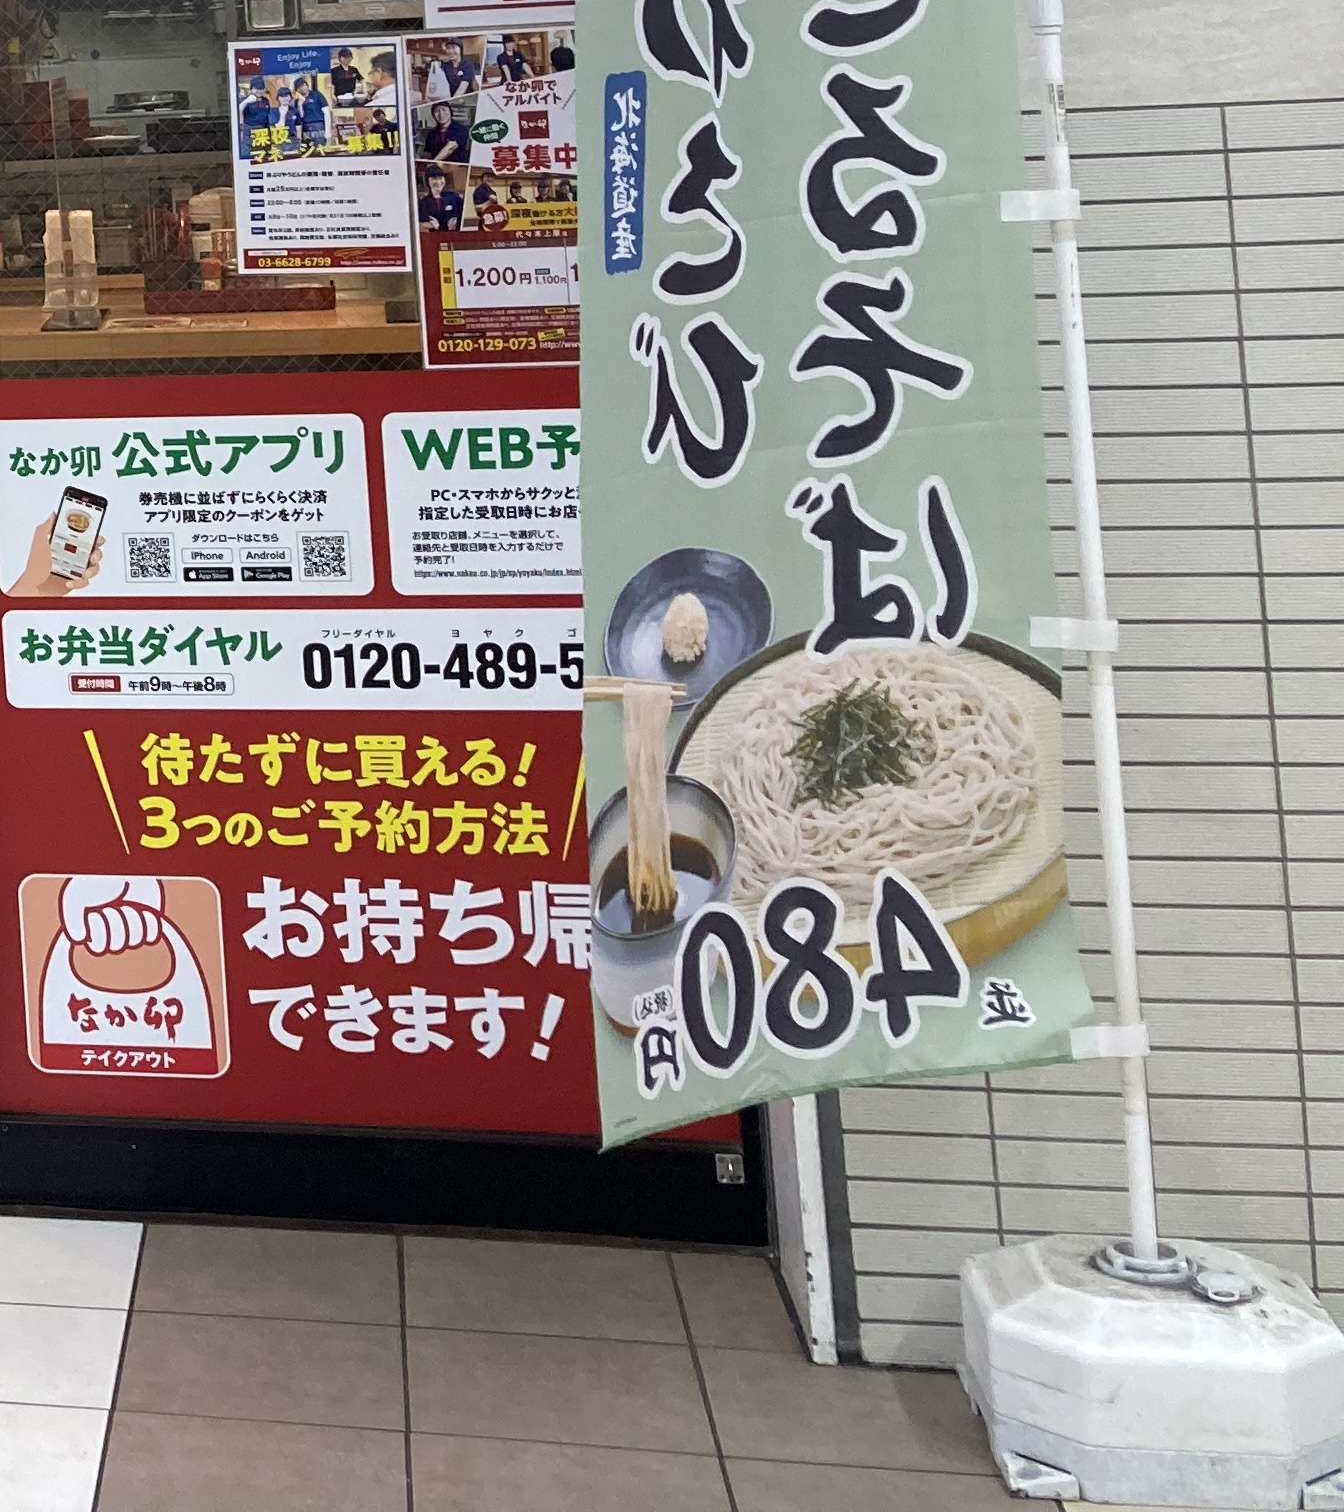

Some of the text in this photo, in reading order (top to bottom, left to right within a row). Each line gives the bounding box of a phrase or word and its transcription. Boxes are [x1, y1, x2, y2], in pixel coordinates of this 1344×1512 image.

[238, 57, 261, 67] なか卯
[504, 79, 556, 93] なか卯で
[502, 94, 562, 107] アルバイト
[521, 119, 547, 130] なか卯
[250, 125, 289, 147] 深夜
[491, 143, 578, 173] 募集中
[510, 206, 578, 220] 深夜働ける方大
[258, 256, 331, 268] 03-6628-6799
[456, 267, 531, 288] 1,200円
[438, 337, 537, 353] 0120-129-073
[9, 426, 347, 479] なか卯 公式アプリ
[138, 489, 328, 506] 券売機に並ばずにらくらく決済
[430, 486, 580, 502] PC・スマホからサクッと
[144, 507, 325, 524] アプリ限定のクーポンをゲット
[418, 505, 580, 521] 指定した受取日時にお店
[191, 533, 280, 544] ダウンロードはこちら
[190, 550, 286, 561] iPhone Android
[412, 542, 564, 553] 連絡先と受取日時を入力するだけで
[320, 629, 397, 639] フリーダイヤル
[19, 624, 284, 667] お弁当ダイヤル
[138, 796, 550, 856] 3つのご予約方法
[66, 993, 183, 1044] なか卯
[80, 1048, 176, 1070] テイクアウト
